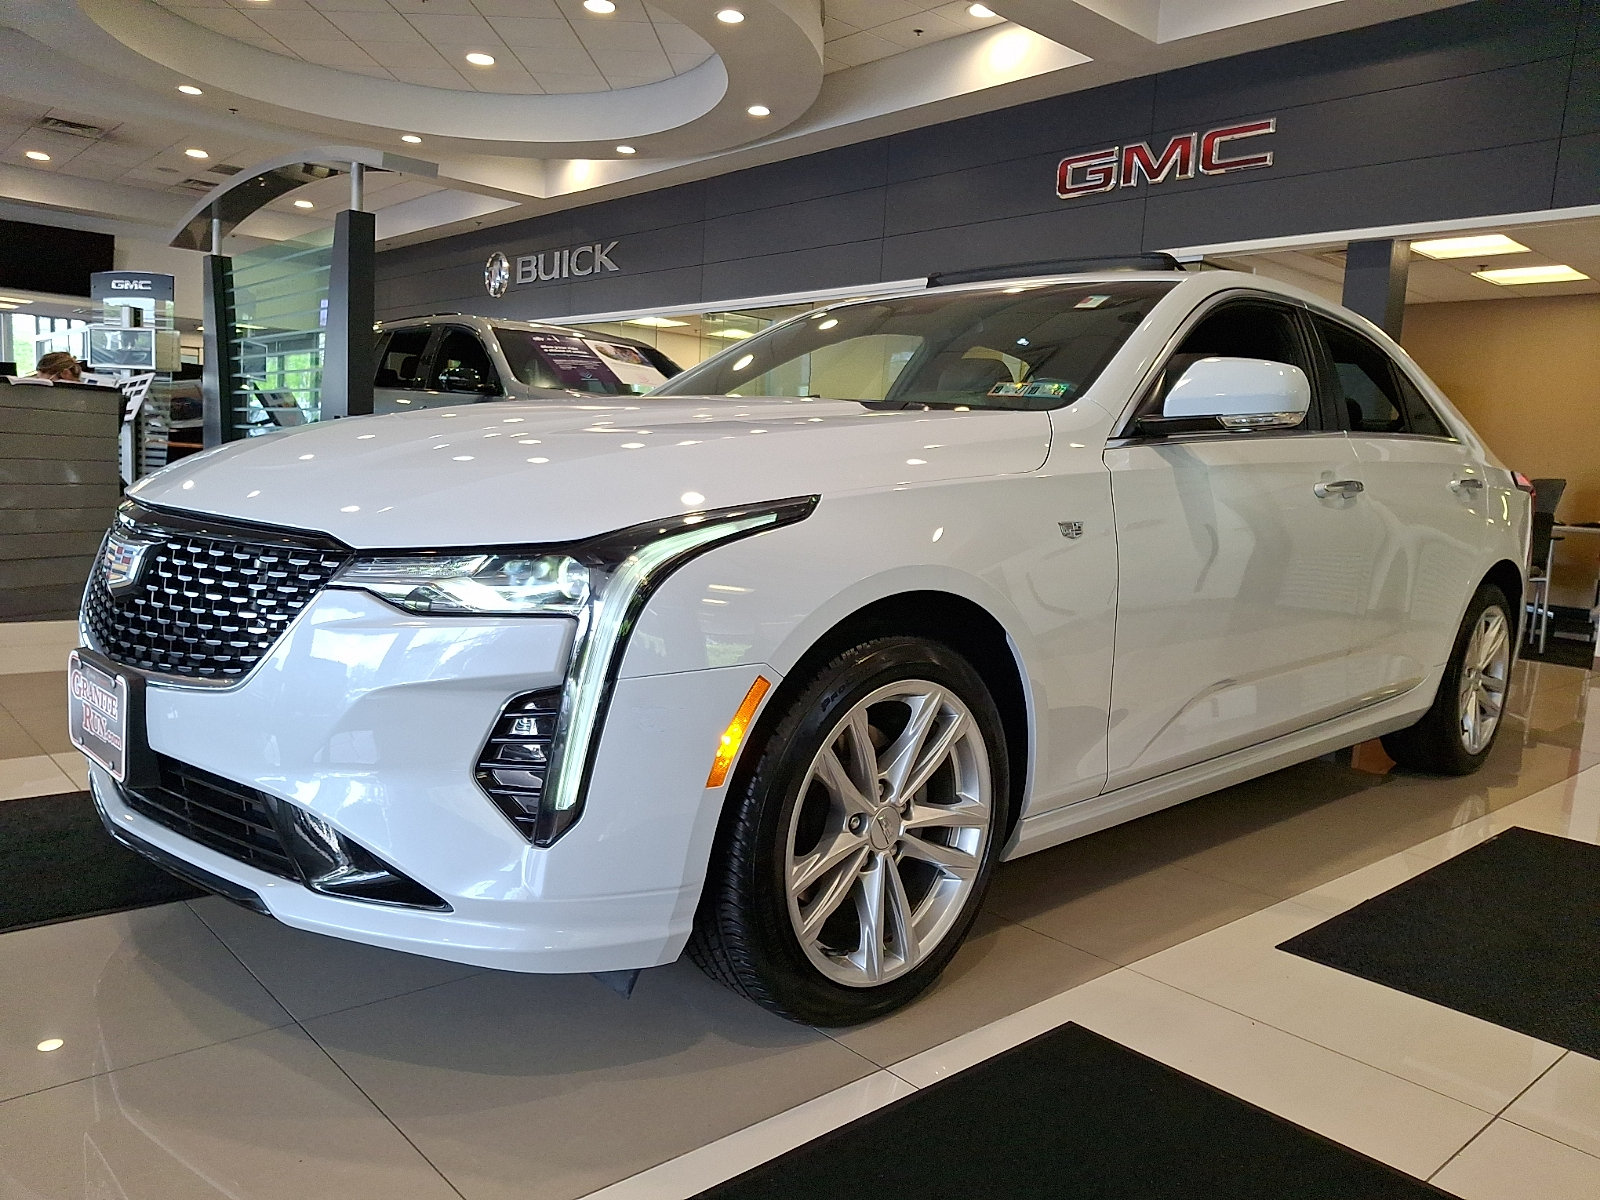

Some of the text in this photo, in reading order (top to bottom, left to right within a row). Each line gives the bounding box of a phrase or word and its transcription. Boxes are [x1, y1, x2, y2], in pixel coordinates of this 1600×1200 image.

[1056, 117, 1276, 199] GMC
[111, 280, 152, 290] GMC
[516, 240, 620, 284] BUICK
[72, 669, 118, 721] GRANITE
